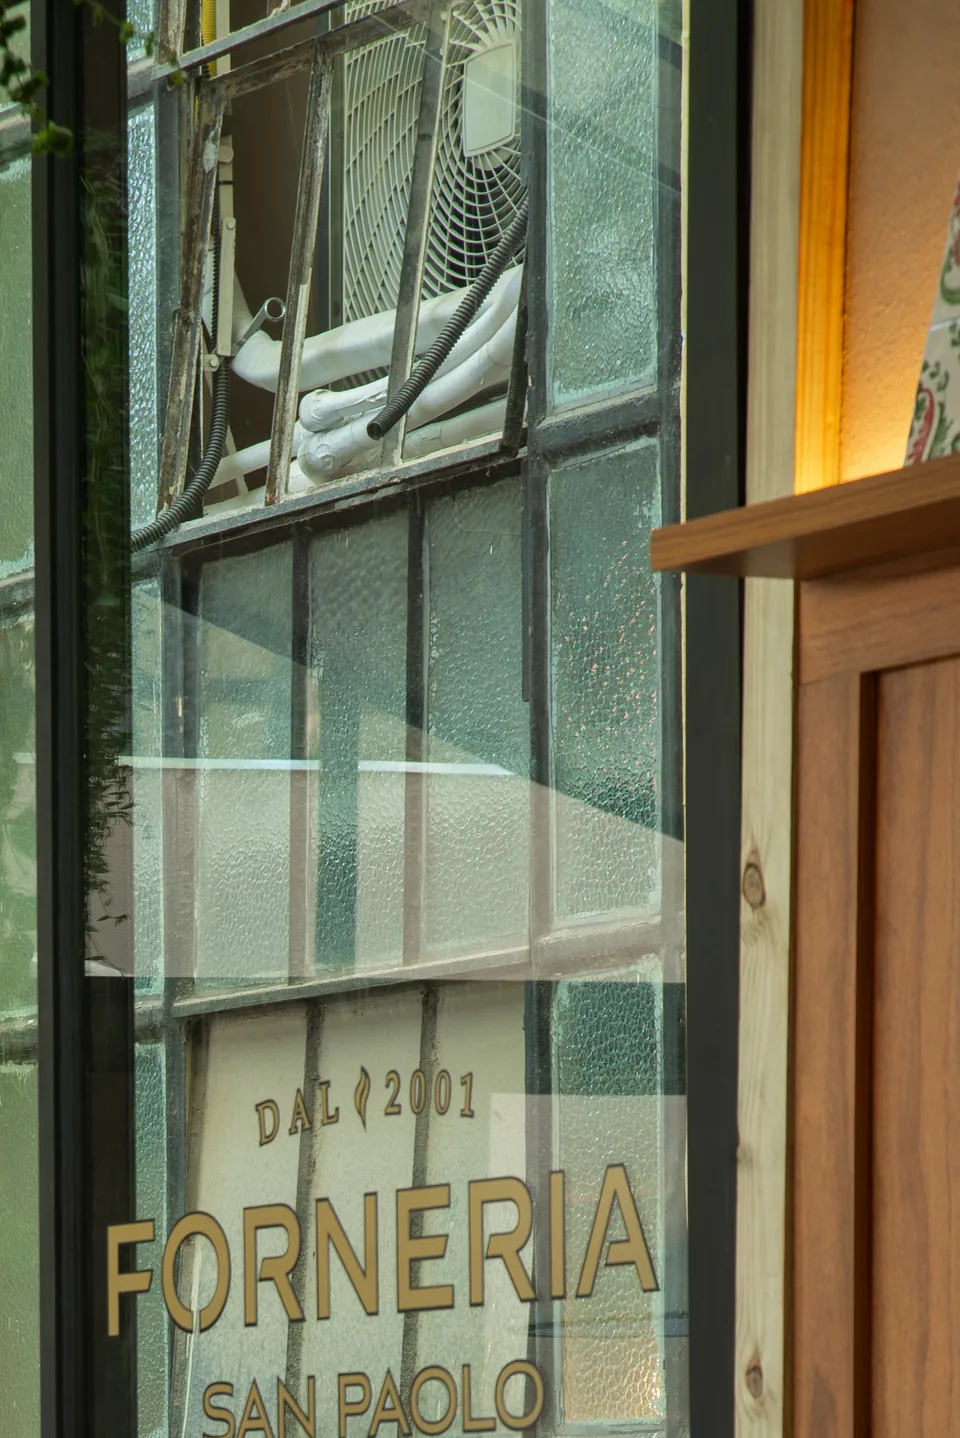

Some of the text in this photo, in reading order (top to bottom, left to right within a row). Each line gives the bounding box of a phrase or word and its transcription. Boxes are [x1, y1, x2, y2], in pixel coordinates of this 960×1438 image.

[255, 1069, 475, 1146] DAL 2001
[107, 1163, 660, 1336] FORNERIA
